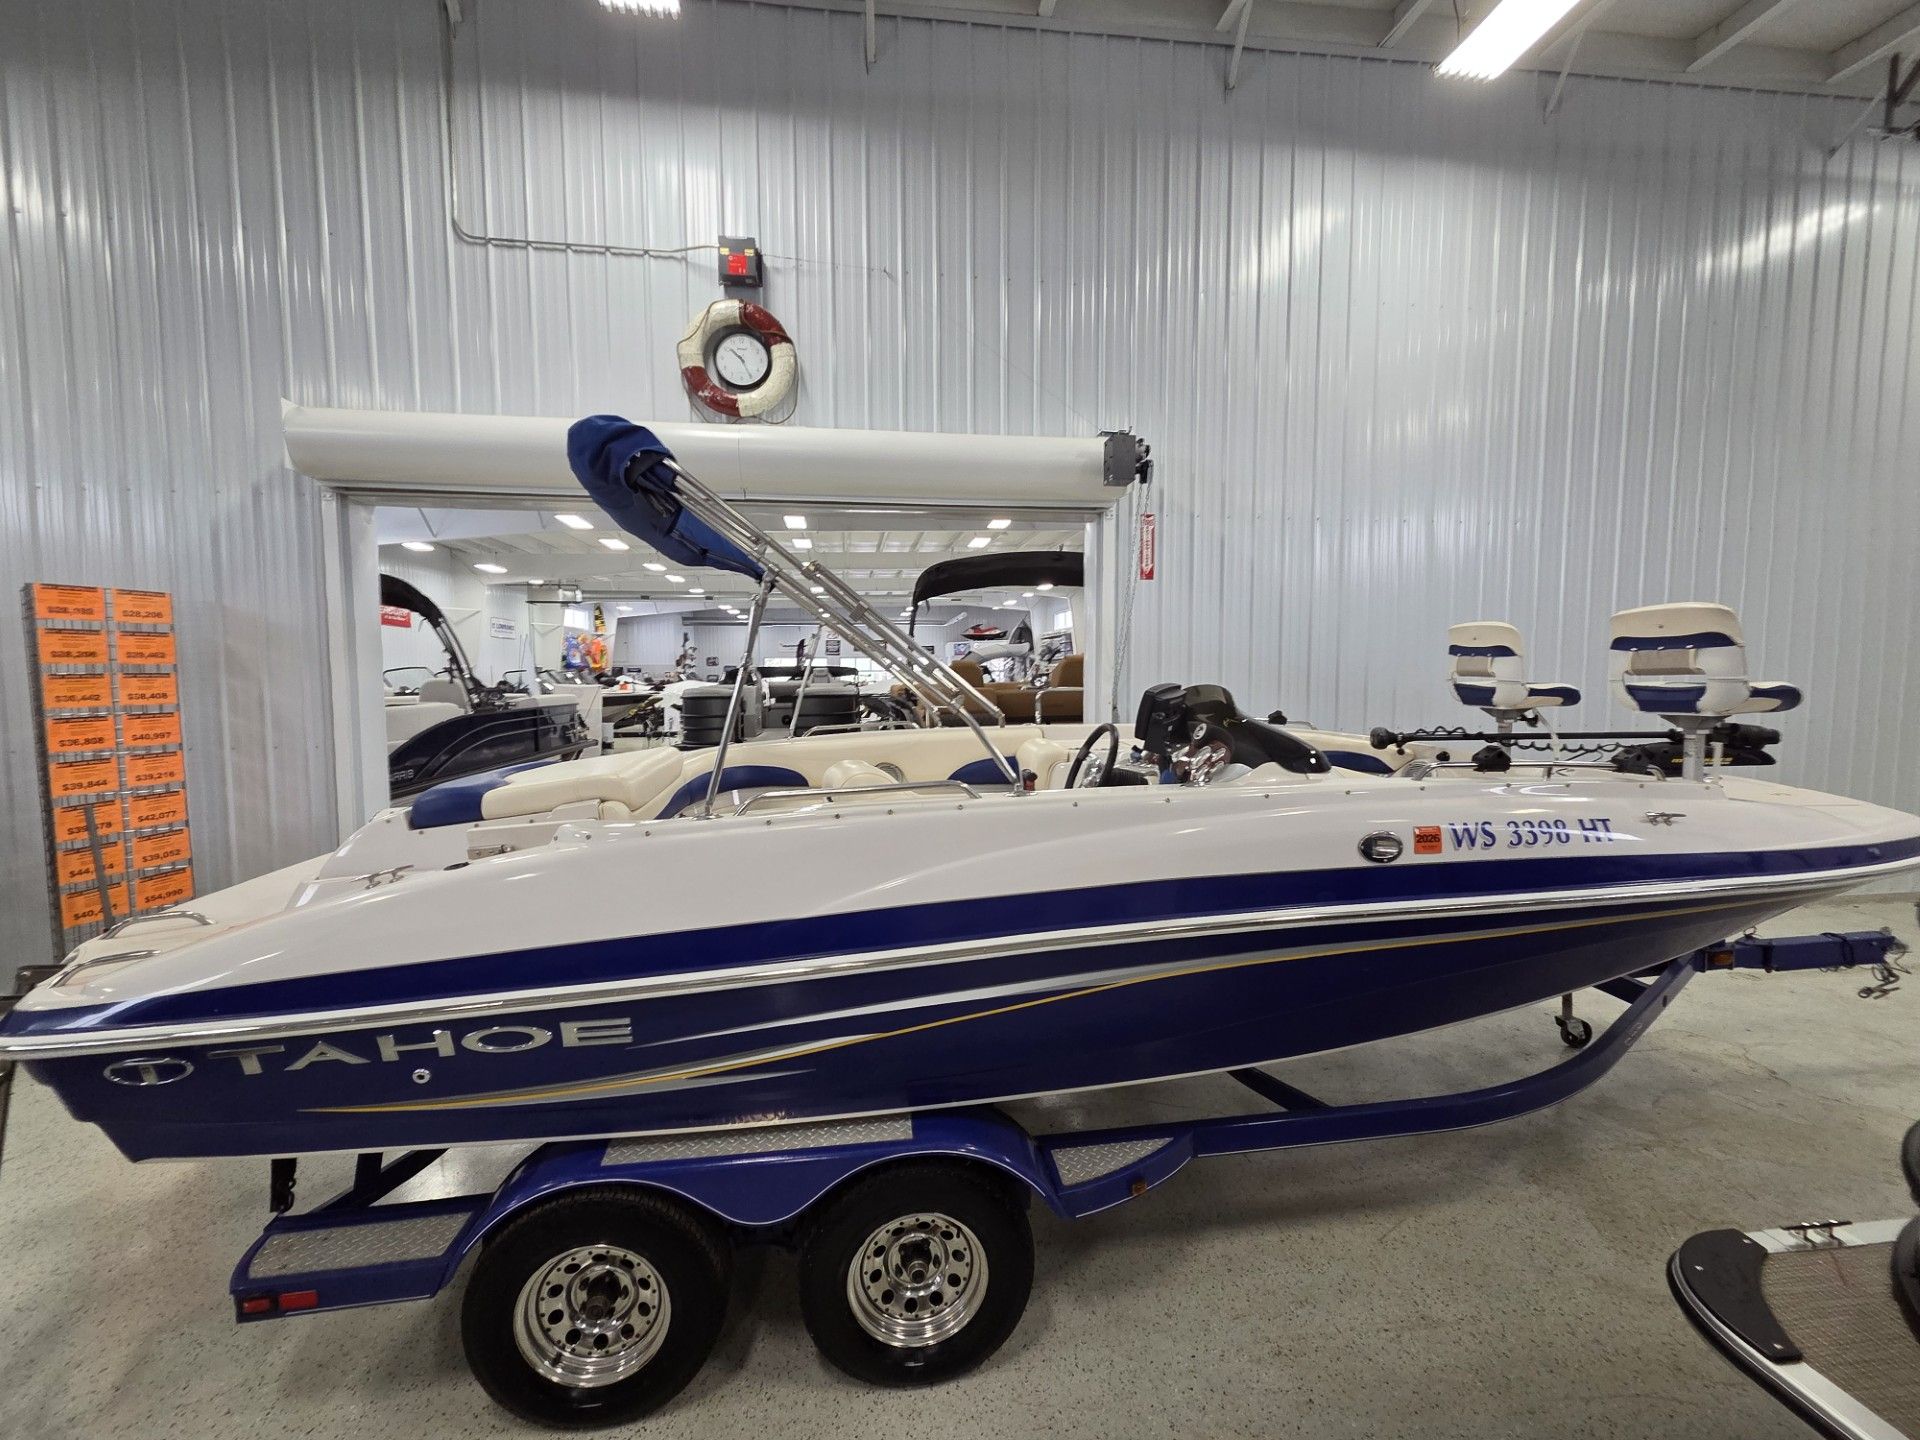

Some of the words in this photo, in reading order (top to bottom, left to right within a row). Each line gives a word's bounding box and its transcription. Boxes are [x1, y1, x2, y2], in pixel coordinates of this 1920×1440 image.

[1415, 834, 1440, 843] 2026
[1449, 821, 1497, 849] WS
[1506, 819, 1571, 847] 3398
[1577, 818, 1615, 843] HT
[207, 1017, 633, 1075] TAHOE
